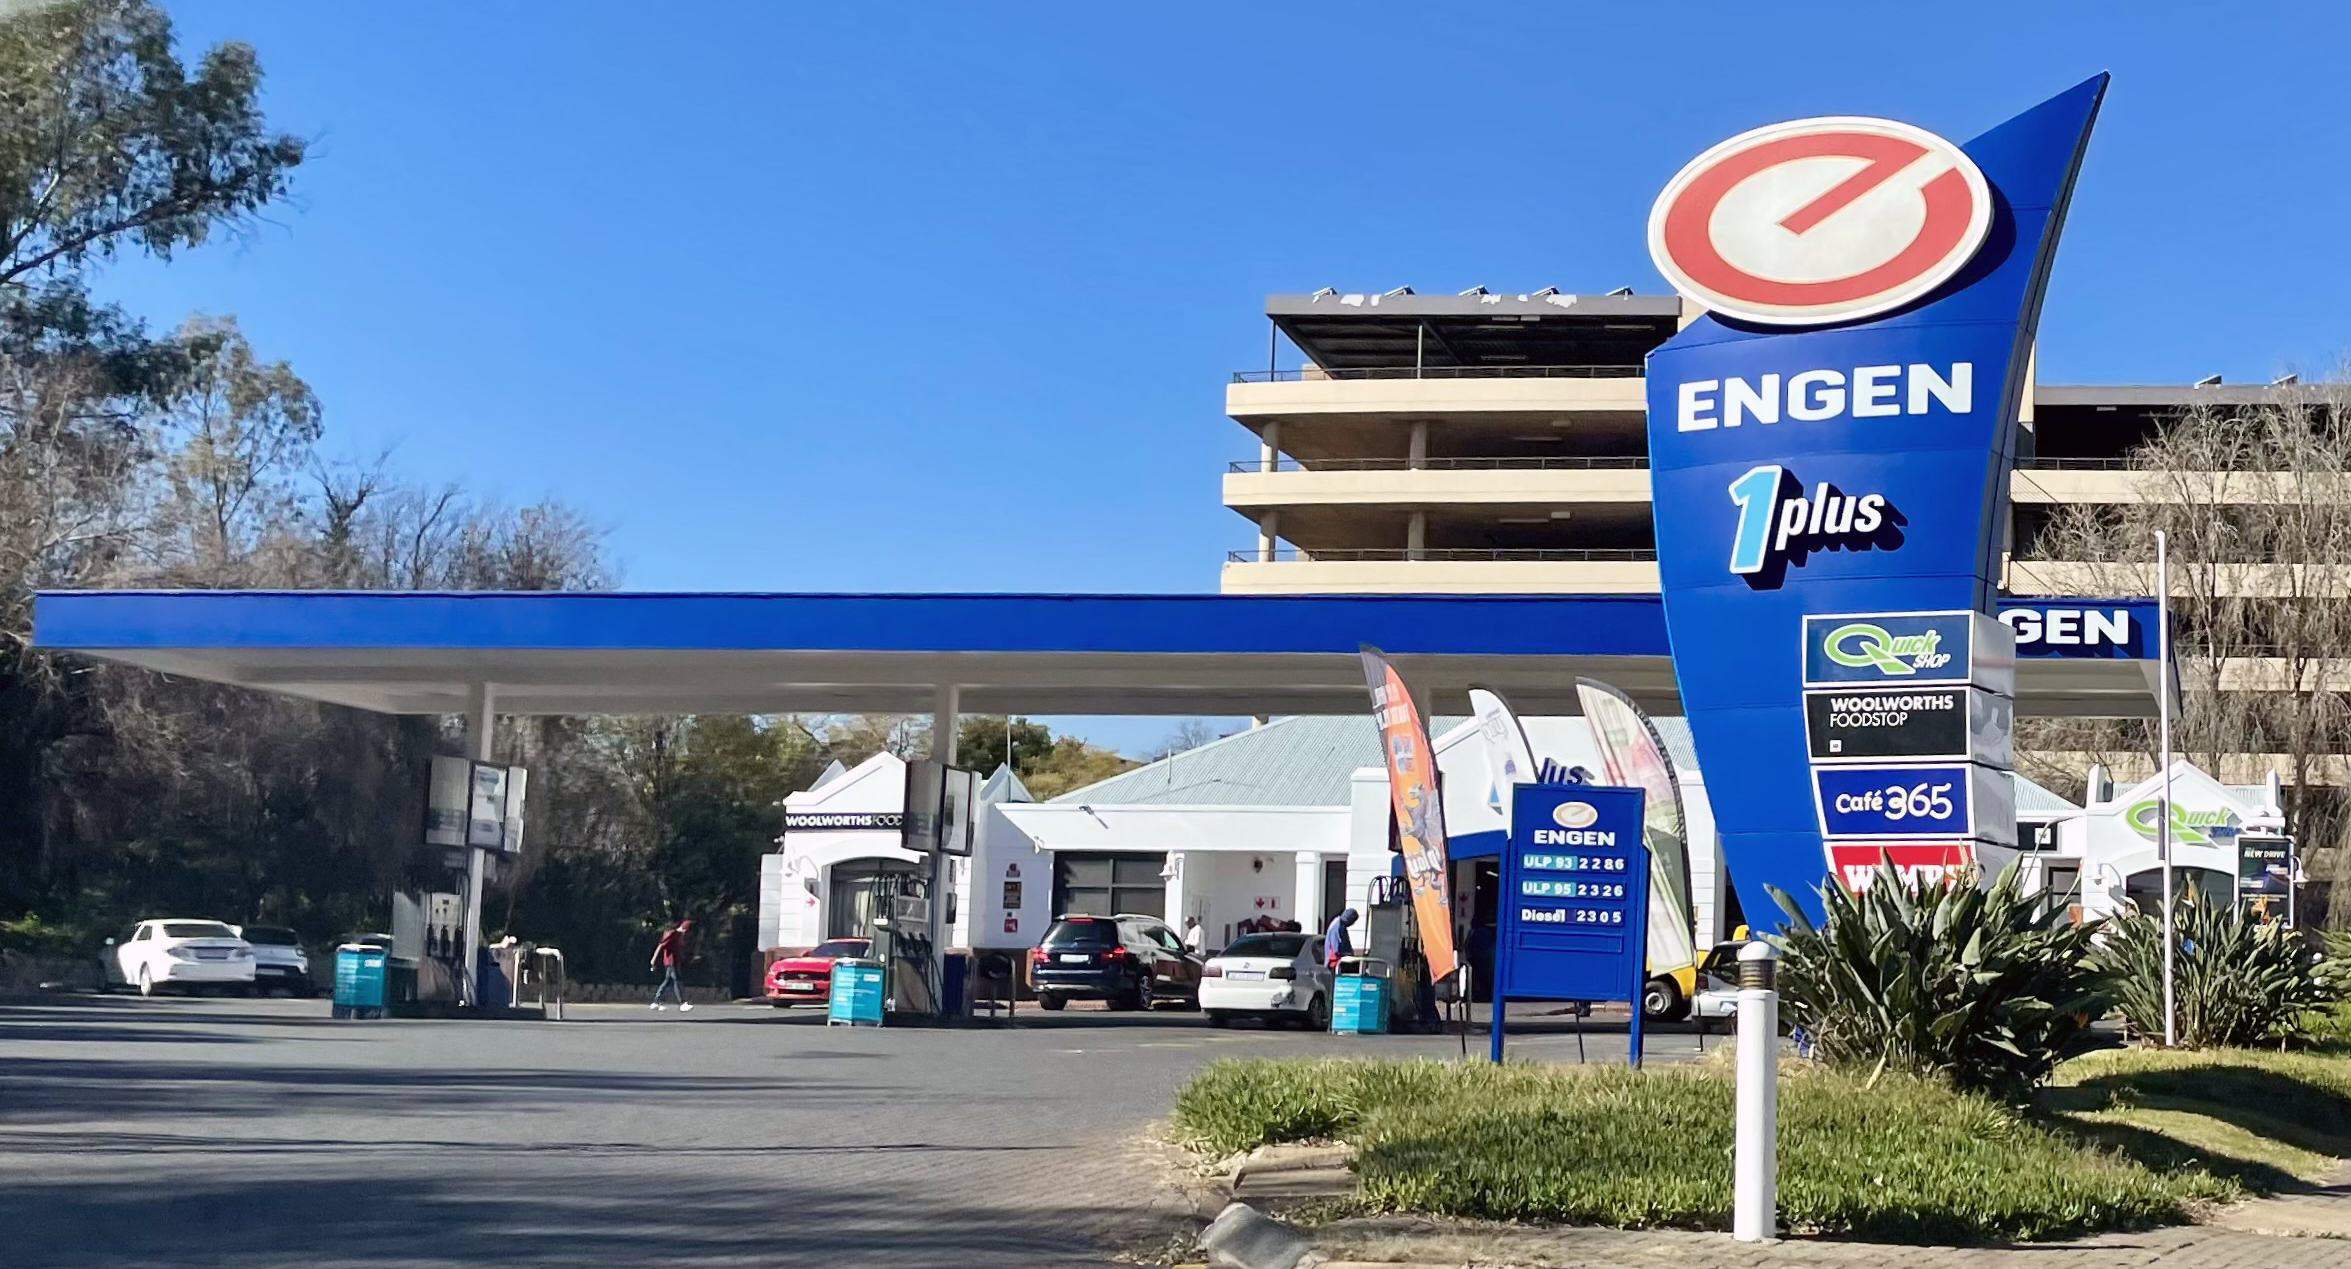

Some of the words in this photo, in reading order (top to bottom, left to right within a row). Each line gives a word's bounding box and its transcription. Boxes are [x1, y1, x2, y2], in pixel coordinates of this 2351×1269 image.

[1676, 362, 1973, 433] ENGEN
[1998, 609, 2130, 645] GEN
[1914, 653, 1951, 668] SHOP
[1830, 695, 1954, 712] WOOLWORTHS
[1829, 712, 1908, 728] FOODSTOP
[1538, 757, 1585, 785] lus
[1835, 789, 1883, 813] Café
[1884, 782, 1953, 820] 365
[785, 815, 872, 826] WOOLWORTHS
[1533, 829, 1616, 846] ENGEN
[1523, 855, 1552, 868] ULP
[1555, 856, 1573, 869] 93
[1522, 881, 1550, 895] ULP
[1554, 883, 1571, 895] 95
[1521, 908, 1566, 923] Diesel
